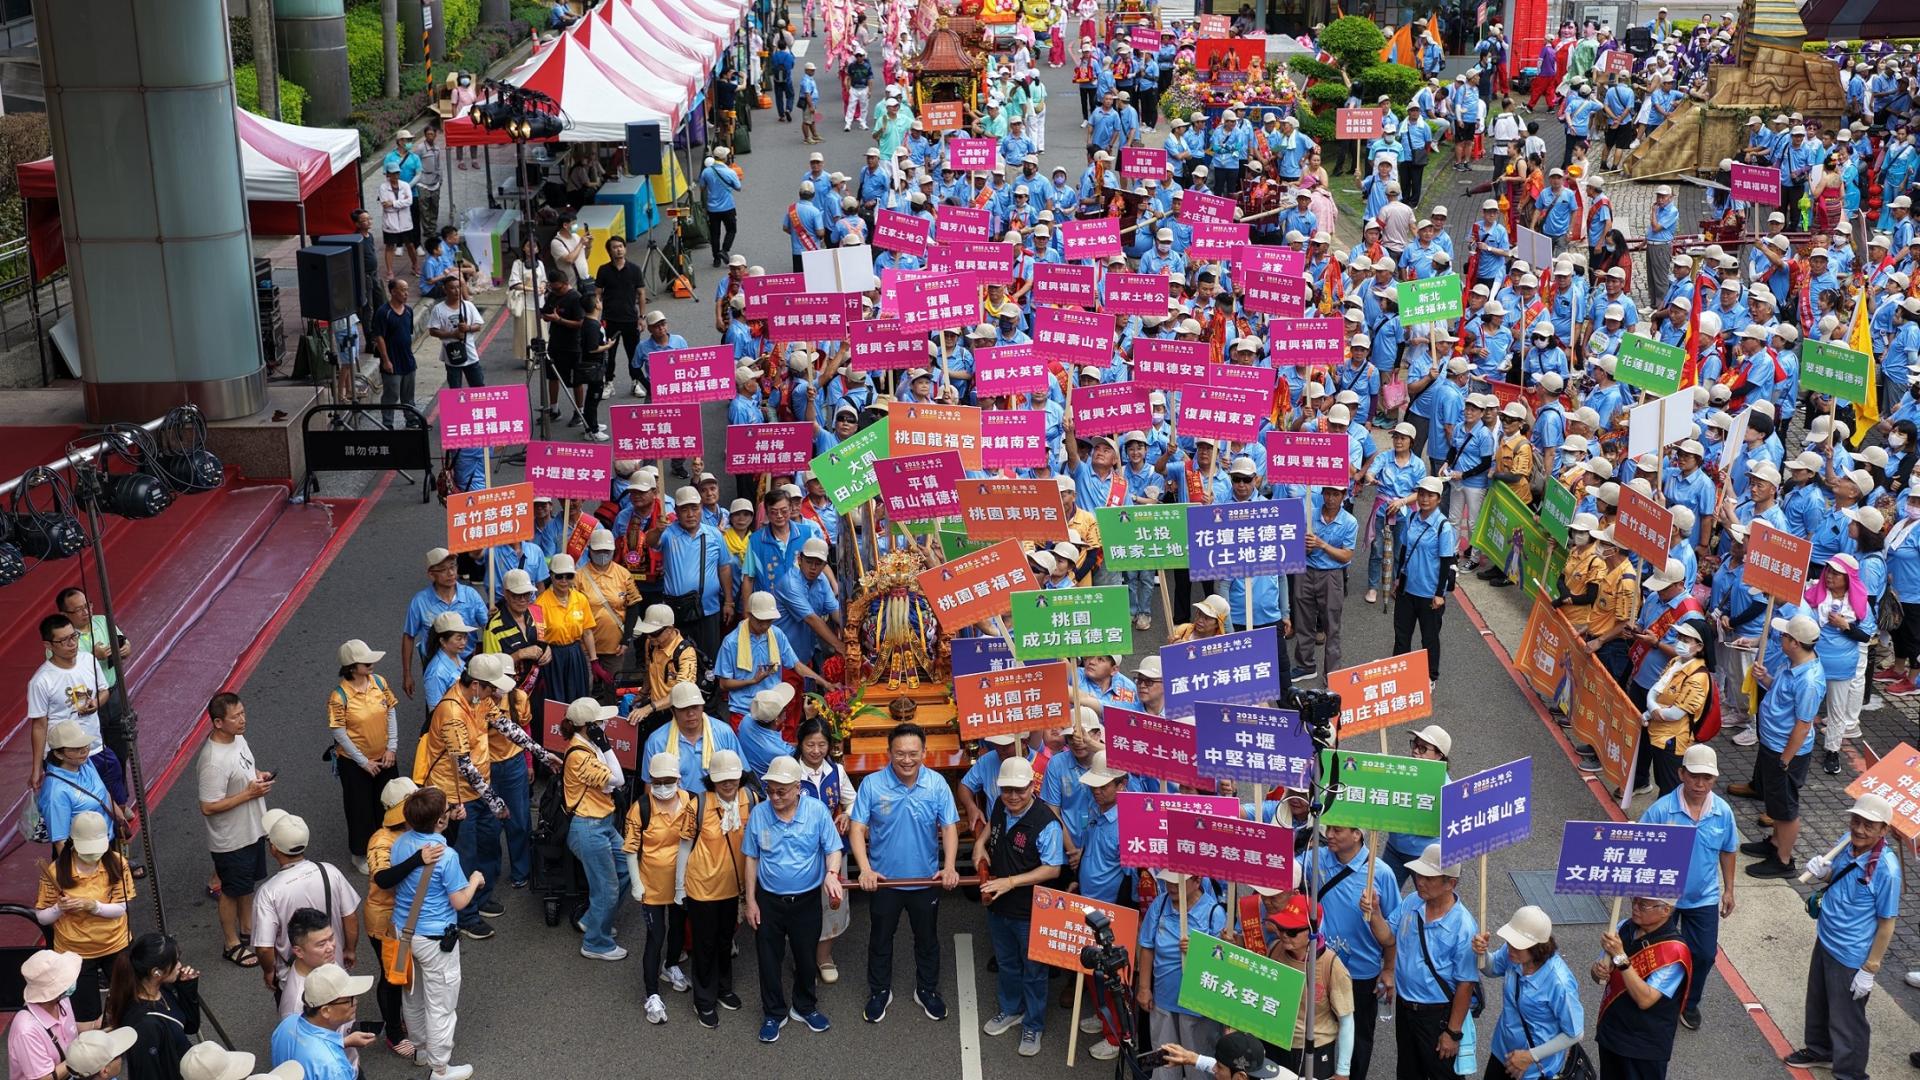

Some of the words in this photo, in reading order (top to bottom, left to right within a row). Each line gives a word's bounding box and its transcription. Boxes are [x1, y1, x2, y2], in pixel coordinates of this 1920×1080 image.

[956, 148, 990, 156] 仁美新村
[1734, 180, 1777, 194] 平鎮福明宮
[878, 226, 924, 244] 莊家土地公
[940, 222, 986, 236] 瑞芳八仙宮
[1066, 234, 1118, 247] 李家土地公
[954, 260, 1009, 270] 復興聖興宮
[926, 294, 950, 307] 復興
[1109, 291, 1165, 303] 吳家土地公
[1248, 288, 1302, 305] 復興東安宮
[1418, 292, 1440, 303] 新北
[1404, 300, 1458, 318] 土城福林宮
[774, 314, 840, 326] 復興德興宮
[856, 338, 923, 353] 復興合興宮
[1038, 330, 1108, 350] 復興壽山宮
[1275, 339, 1340, 351] 復興福南宮
[674, 366, 711, 379] 田心里
[980, 364, 1044, 381] 復興大英宮
[1139, 360, 1205, 376] 復興德安宮
[1622, 354, 1678, 382] 花蓮鎮賢宮
[656, 377, 730, 394] 新興路福德宮
[471, 408, 497, 420] 復興
[1078, 402, 1146, 421] 復興大興宮
[1184, 407, 1256, 426] 復興福東宮
[447, 420, 524, 437] 三民里福興宮
[641, 422, 672, 434] 平鎮
[618, 436, 696, 451] 瑤池慈惠宮
[754, 440, 785, 452] 楊梅
[894, 430, 976, 450] 桃園龍福宮
[344, 445, 390, 456] 請勿停車
[732, 451, 806, 466] 亞洲福德宮
[847, 450, 878, 476] 大園
[1272, 454, 1344, 469] 復興豐福宮
[530, 466, 606, 482] 中壢建安亭
[908, 475, 939, 490] 平鎮
[452, 502, 528, 528] 蘆竹慈母宮
[968, 506, 1058, 521] 桃園東明宮
[1228, 506, 1280, 518] 2025土地公
[462, 522, 521, 545] (韓國媽)
[1134, 527, 1172, 541] 北投
[1195, 524, 1297, 547] 花壇崇德宮
[1619, 510, 1666, 550] 蘆竹長興宮
[1110, 544, 1189, 560] 陳家土地
[1208, 544, 1286, 568] (土地婆)
[1750, 549, 1803, 584] 桃園延德宮
[1051, 610, 1092, 628] 桃園
[1022, 628, 1123, 648] 成功福德宮
[1202, 637, 1252, 652] 2025土地公
[1364, 662, 1408, 676] 2025土地公
[1171, 662, 1272, 695] 蘆竹海福宮
[984, 688, 1041, 708] 桃園市
[1363, 680, 1397, 702] 富岡
[966, 702, 1063, 727] 中山福德宮
[1236, 712, 1288, 725] 2025土地公
[1142, 719, 1191, 736] 2025土地公
[1234, 730, 1276, 750] 中壢
[1204, 748, 1306, 775] 中堅福德宮
[1362, 760, 1418, 773] 2025土地公
[1474, 770, 1513, 790] 2025土地公
[1160, 800, 1213, 810] 2025土地公
[1447, 796, 1527, 838] 大古山福山宮
[1212, 821, 1266, 836] 2025土地公
[1610, 829, 1668, 840] 2025土地公
[1176, 839, 1286, 870] 南勢慈惠堂
[1602, 846, 1648, 865] 新豐
[1565, 865, 1680, 886] 文財福德宮
[1064, 920, 1096, 936] 馬來西
[1228, 951, 1280, 978] 2025土地公
[1200, 971, 1280, 1018] 新永安宮
